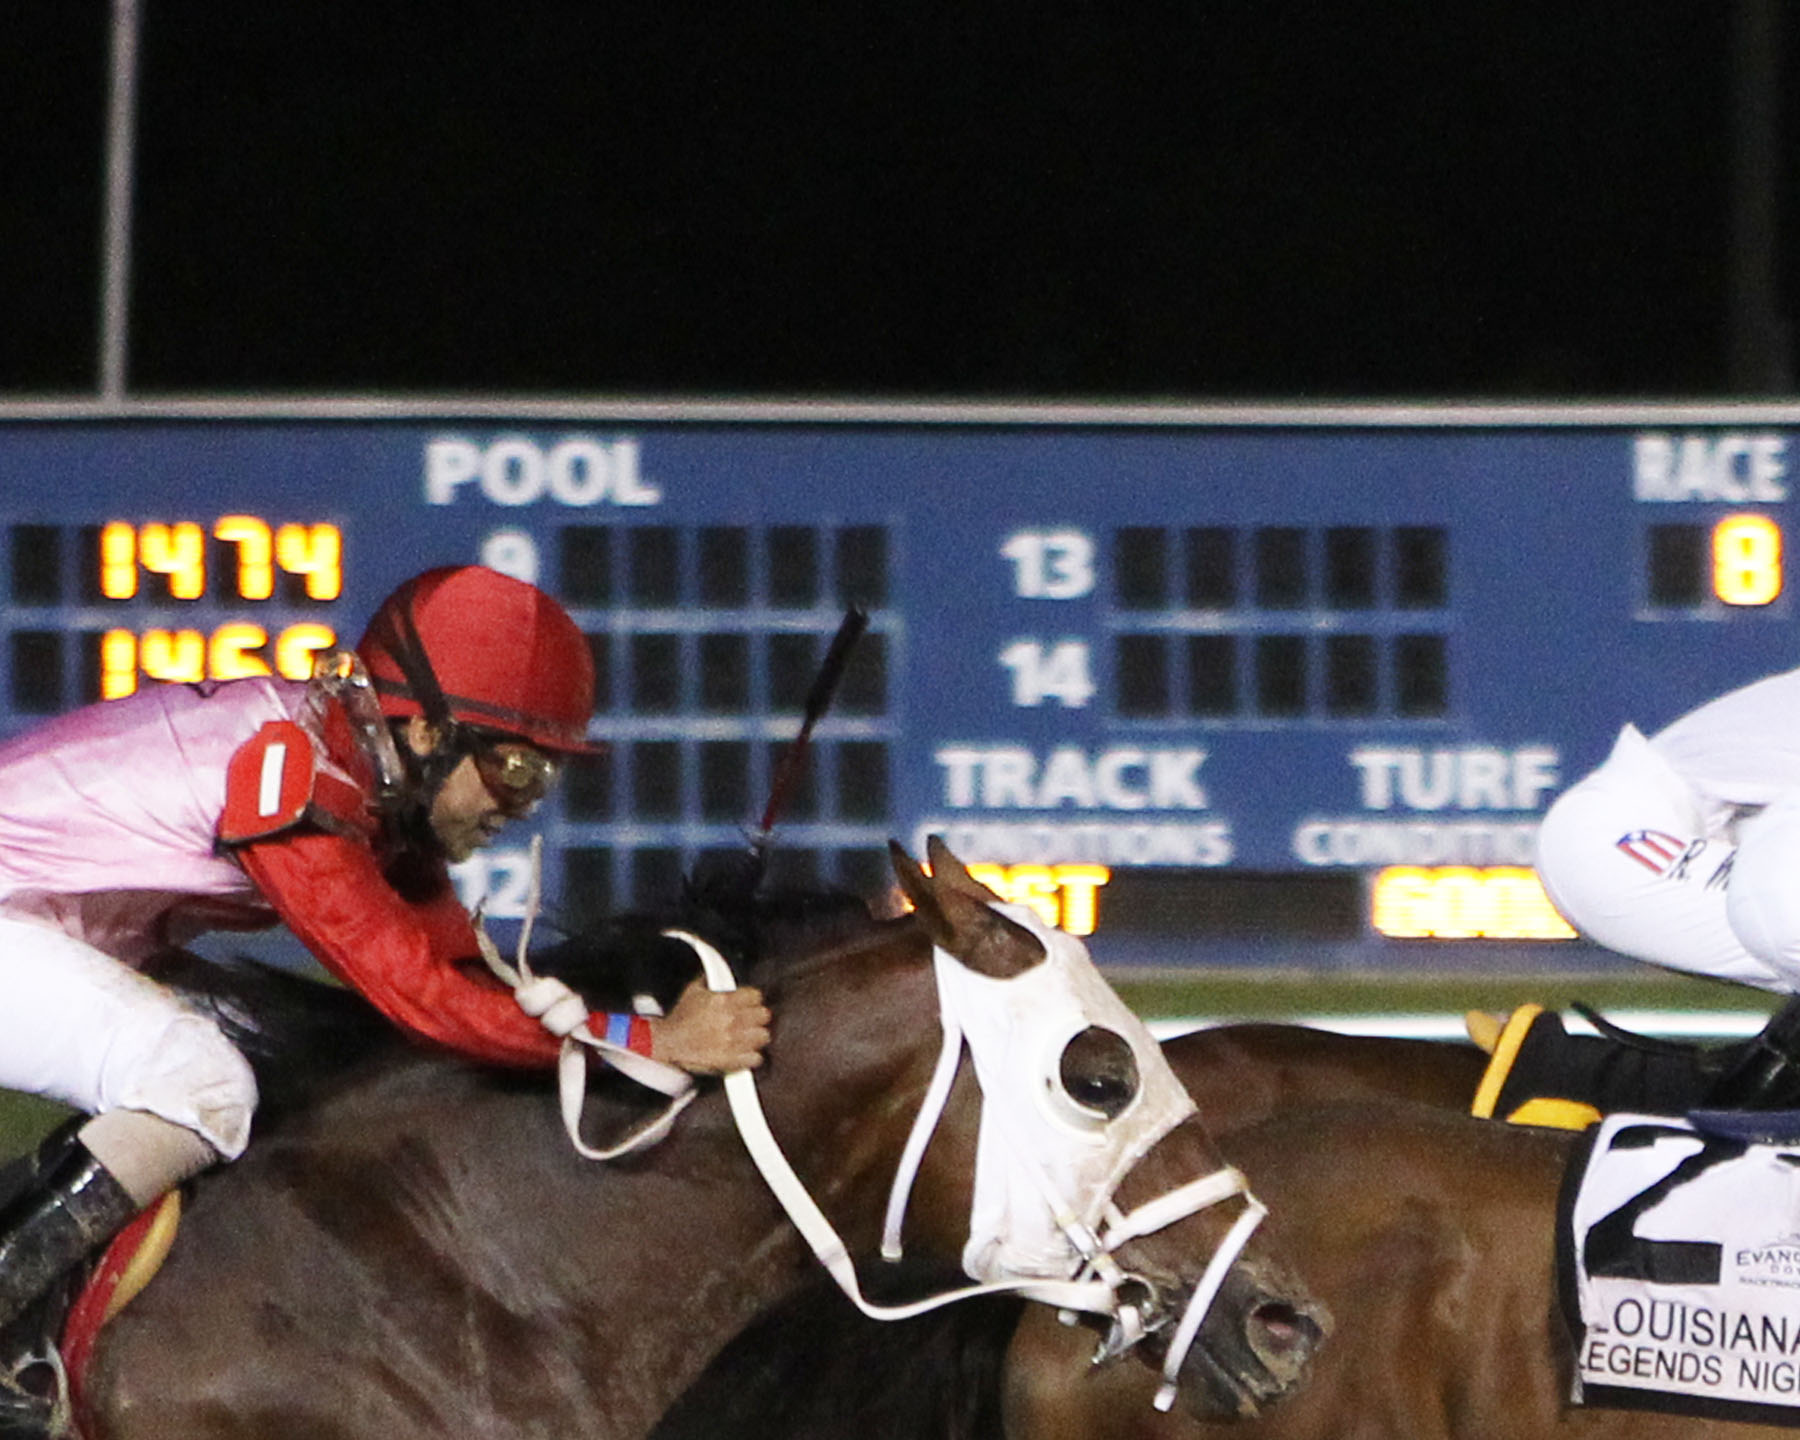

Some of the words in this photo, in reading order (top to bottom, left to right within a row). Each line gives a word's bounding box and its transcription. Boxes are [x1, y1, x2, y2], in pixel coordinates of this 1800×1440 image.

[426, 438, 660, 506] POOL
[1634, 434, 1786, 501] RACE
[101, 514, 343, 600] 1474
[1001, 528, 1095, 599] 13
[1712, 513, 1782, 606] 8
[1001, 638, 1095, 708] 14
[257, 743, 287, 818] 1
[934, 745, 1208, 810] TRACK
[1350, 745, 1560, 810] TURF
[1578, 1340, 1722, 1386] EGENDS
